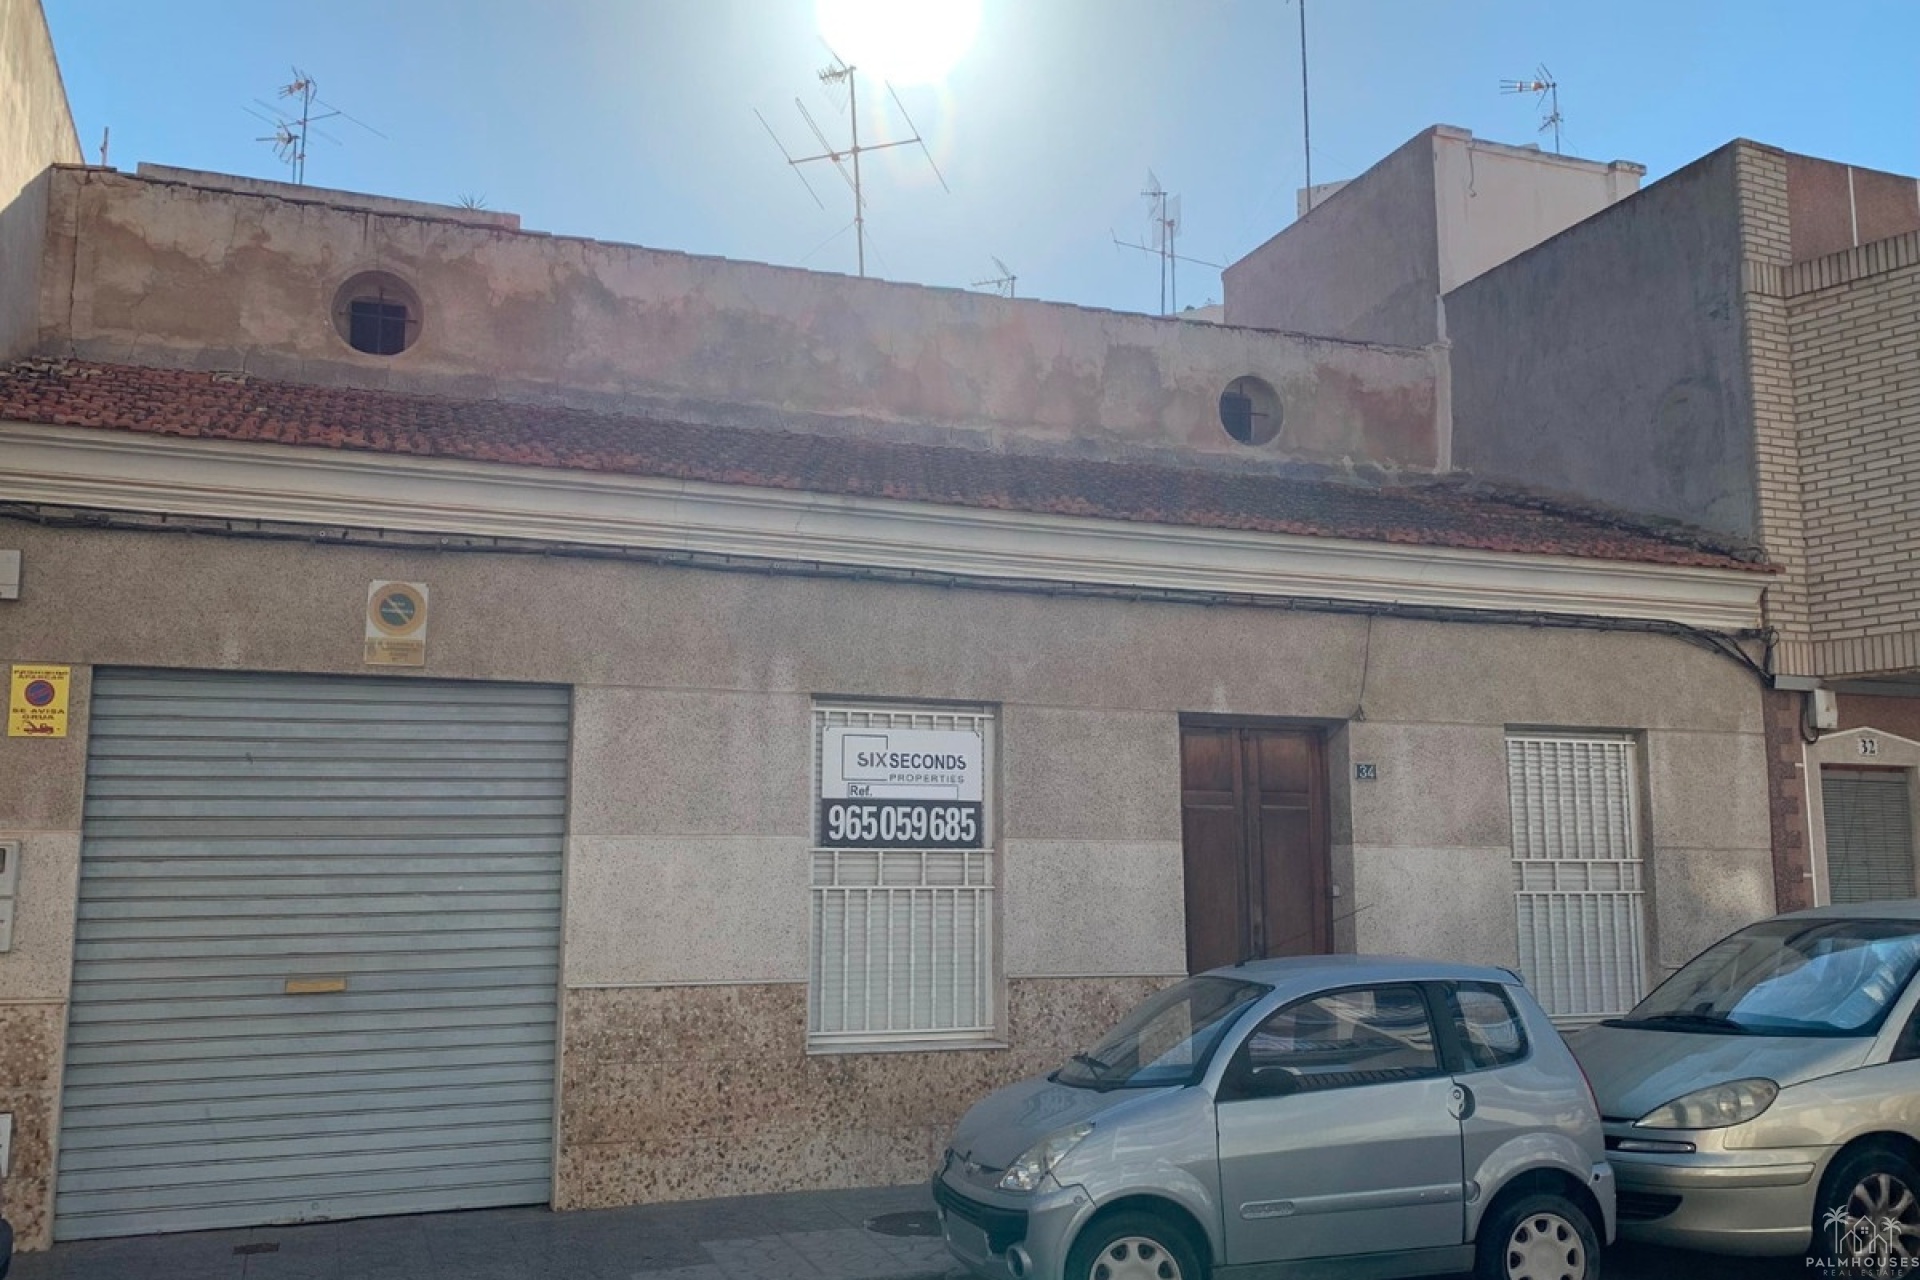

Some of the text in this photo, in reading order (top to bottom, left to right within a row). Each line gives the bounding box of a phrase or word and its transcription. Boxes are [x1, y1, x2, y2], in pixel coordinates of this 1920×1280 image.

[1359, 764, 1375, 778] 34
[889, 773, 965, 783] PROPERTIES
[850, 785, 873, 797] Ref.
